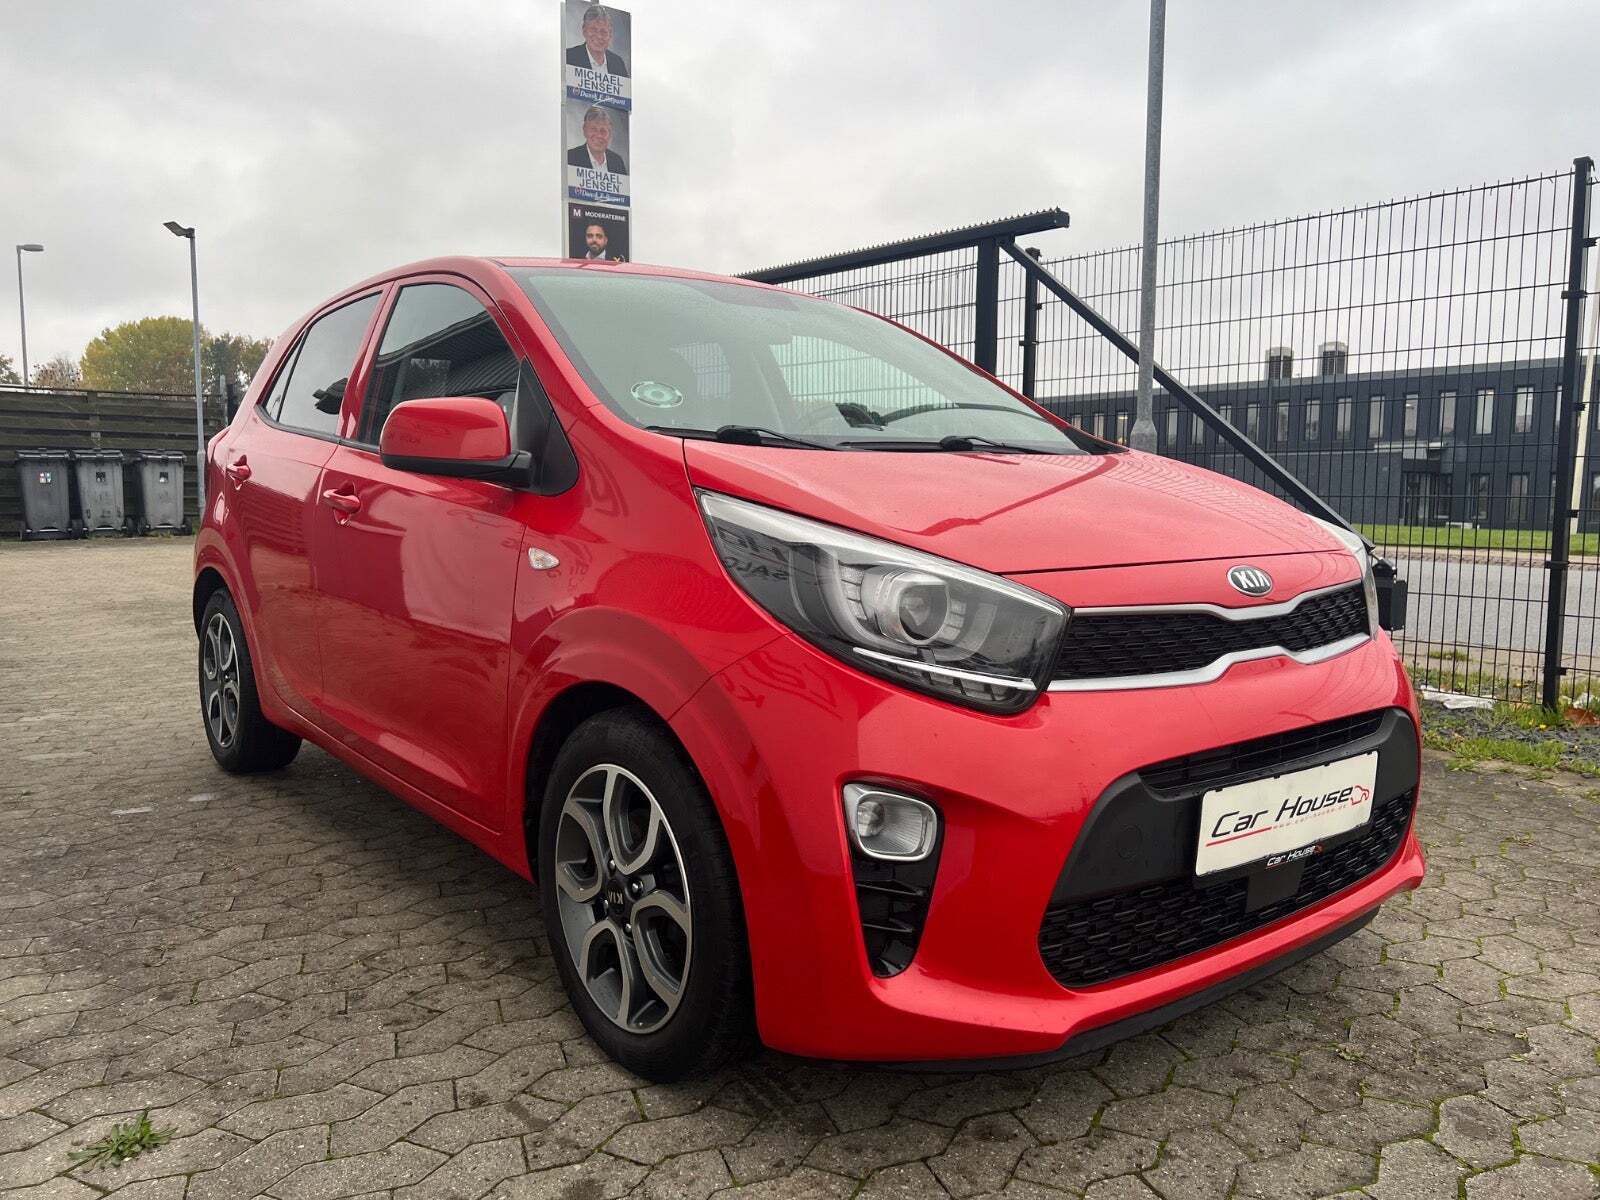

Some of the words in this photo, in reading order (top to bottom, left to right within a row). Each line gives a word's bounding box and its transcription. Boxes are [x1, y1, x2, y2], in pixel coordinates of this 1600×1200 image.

[575, 68, 623, 87] MICHAEL
[578, 80, 620, 95] JENSEN
[576, 168, 623, 185] MICHAEL
[579, 179, 620, 193] JENSEN
[573, 209, 581, 217] M
[1211, 810, 1269, 838] Car
[1274, 786, 1354, 822] House
